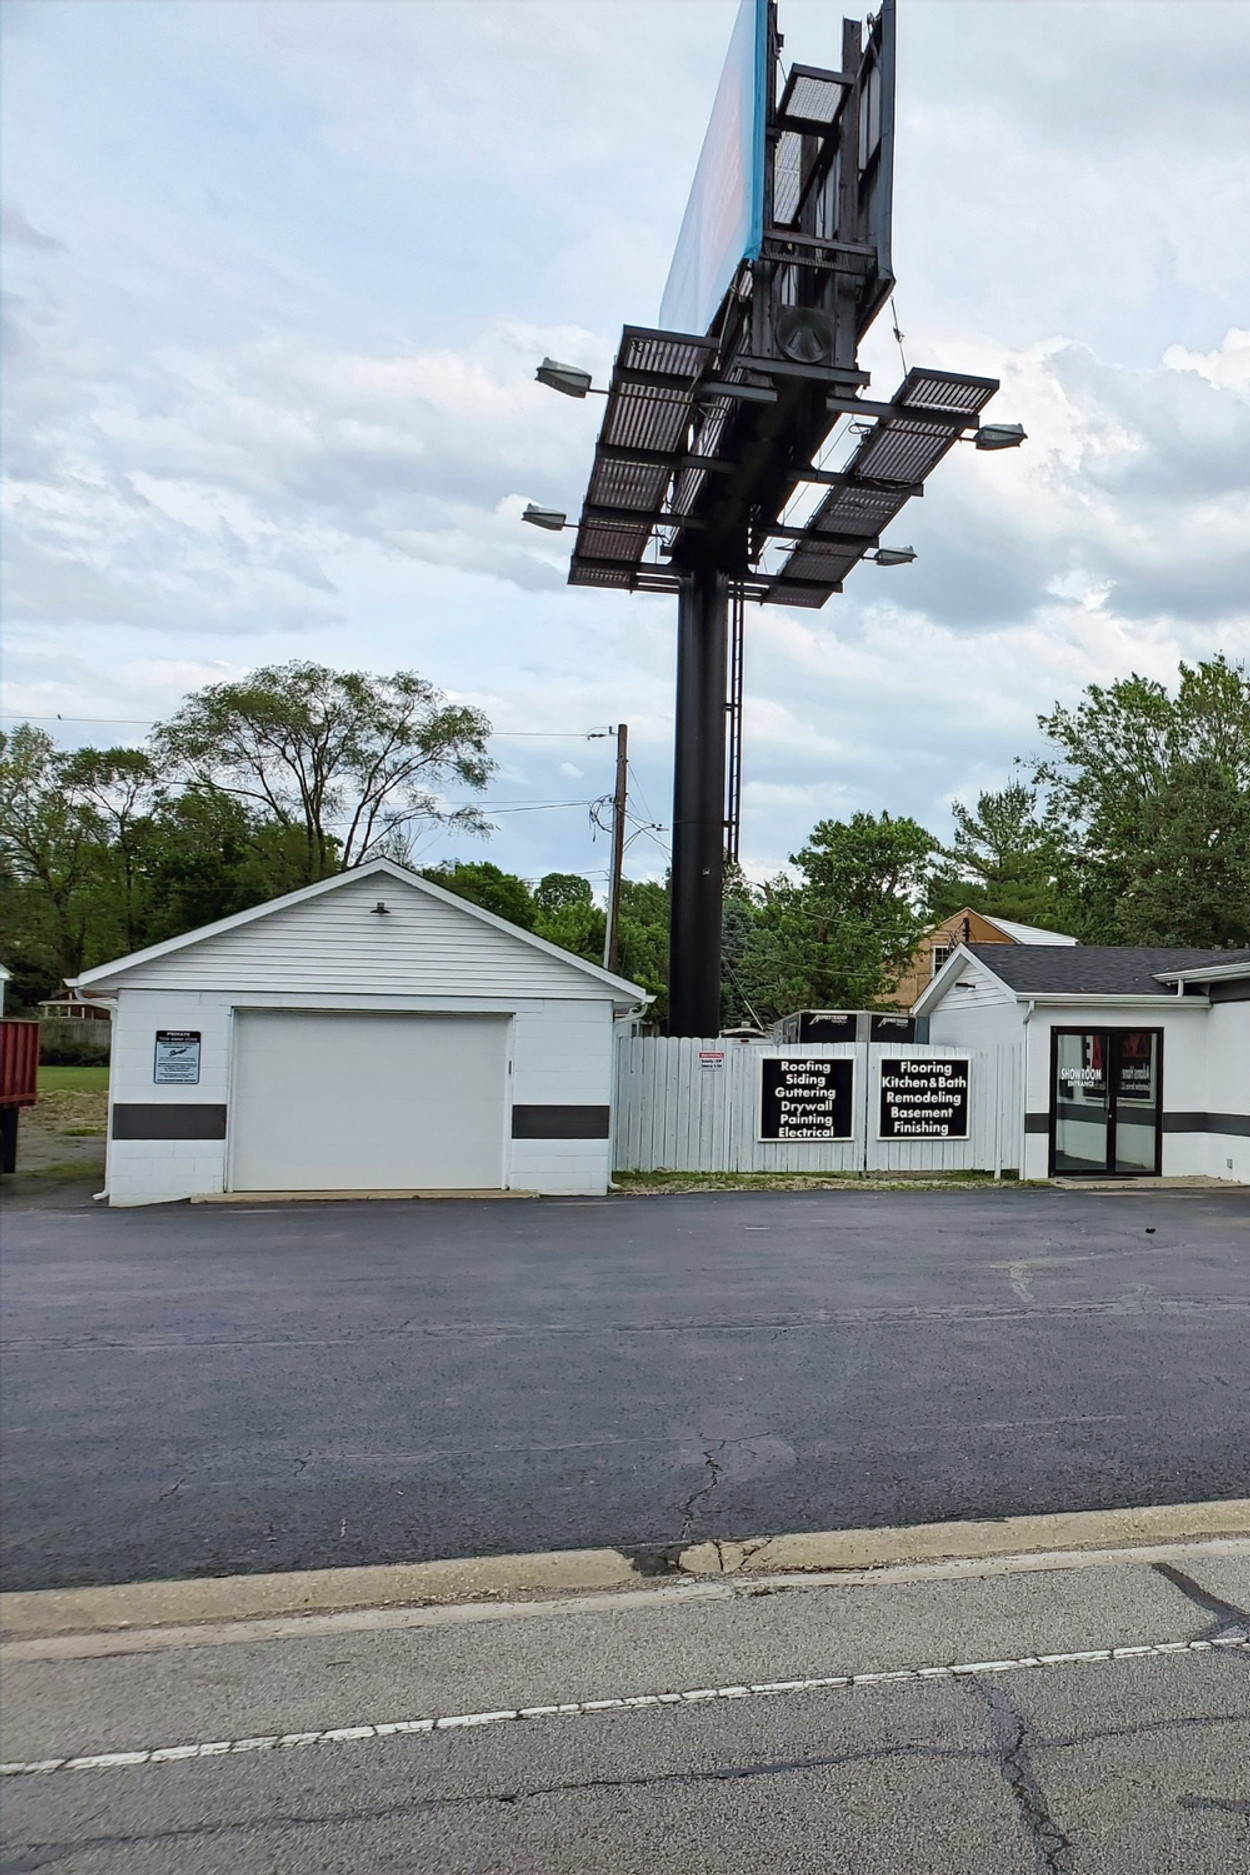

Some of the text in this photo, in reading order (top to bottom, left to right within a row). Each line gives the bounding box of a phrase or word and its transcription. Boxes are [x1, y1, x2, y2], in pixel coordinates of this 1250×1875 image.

[781, 1061, 831, 1074] Roofing
[900, 1062, 952, 1076] Flooring
[786, 1074, 826, 1087] Siding
[775, 1087, 836, 1100] Guttering
[886, 1092, 962, 1106] Remodeling
[781, 1100, 833, 1114] Drywall
[891, 1107, 953, 1118] Basement
[780, 1113, 833, 1127] Painting
[778, 1126, 834, 1138] Electrical
[893, 1121, 949, 1136] Finishing
